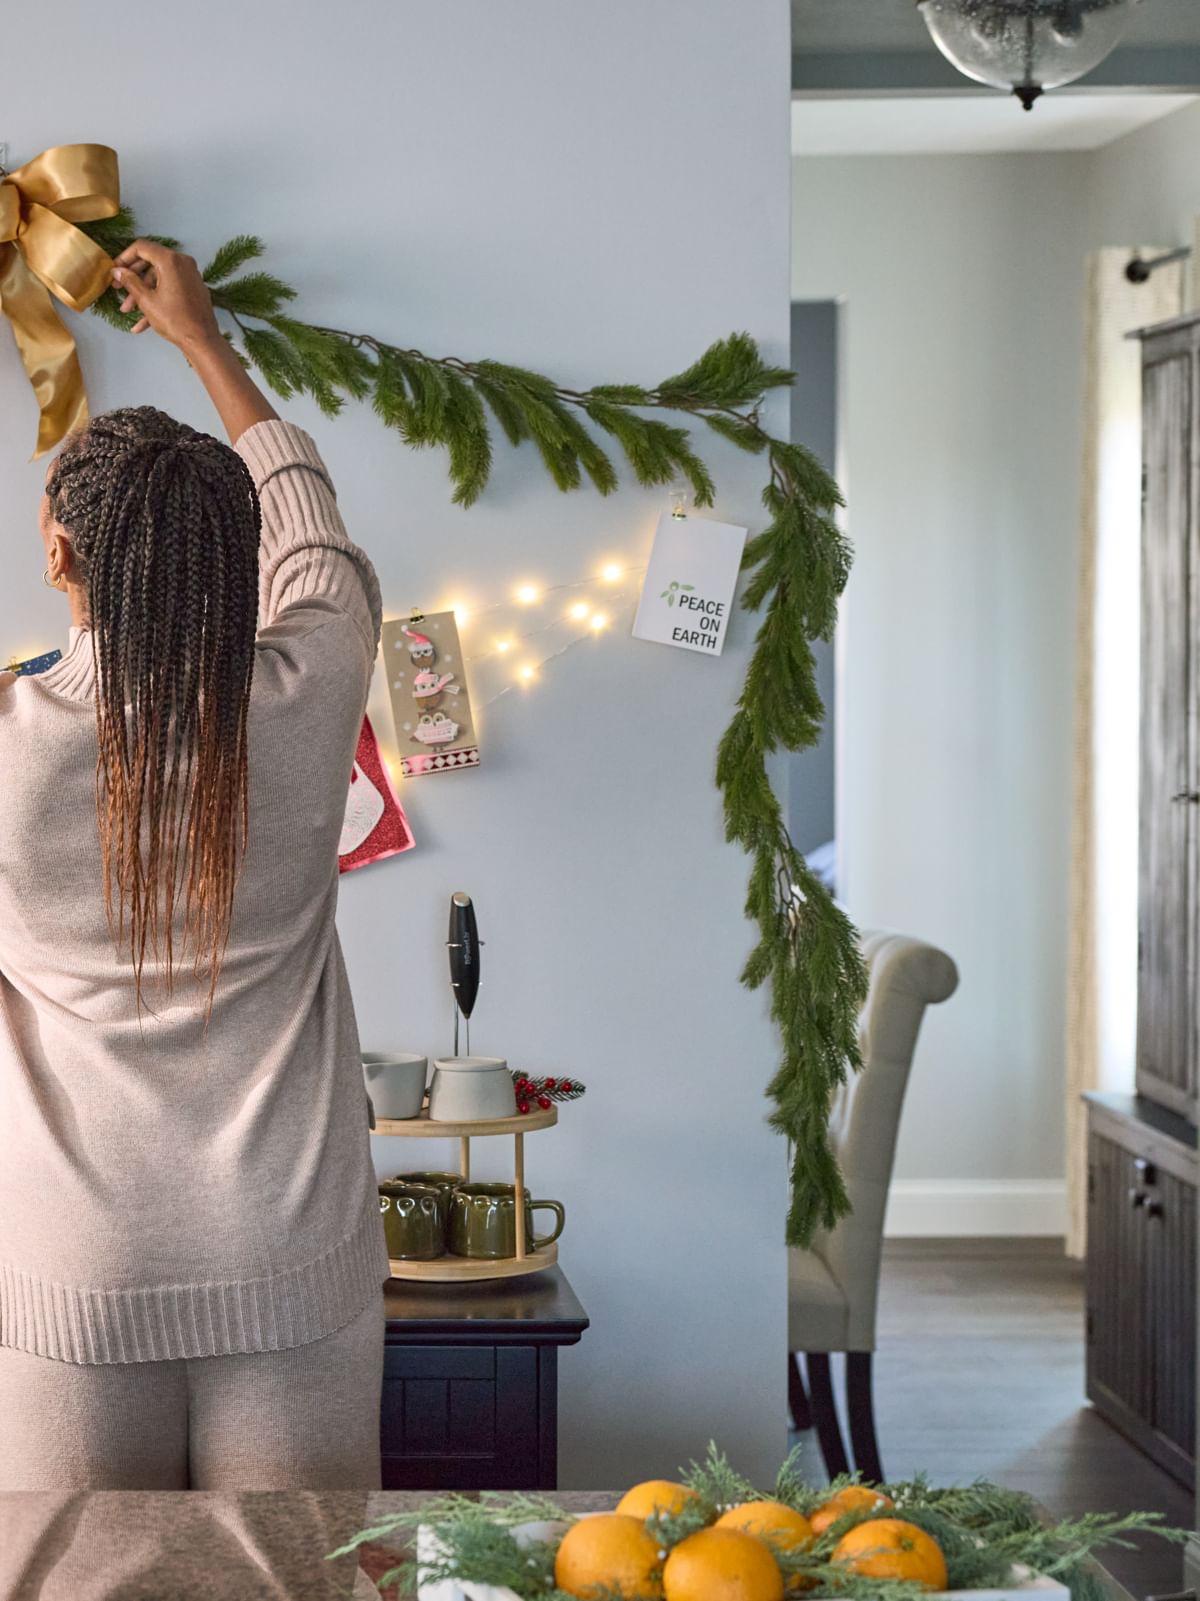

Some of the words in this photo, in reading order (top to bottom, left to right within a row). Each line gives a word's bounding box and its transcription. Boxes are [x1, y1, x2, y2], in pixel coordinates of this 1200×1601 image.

[679, 595, 725, 616] PEACE
[700, 617, 720, 632] ON
[672, 627, 717, 648] EARTH
